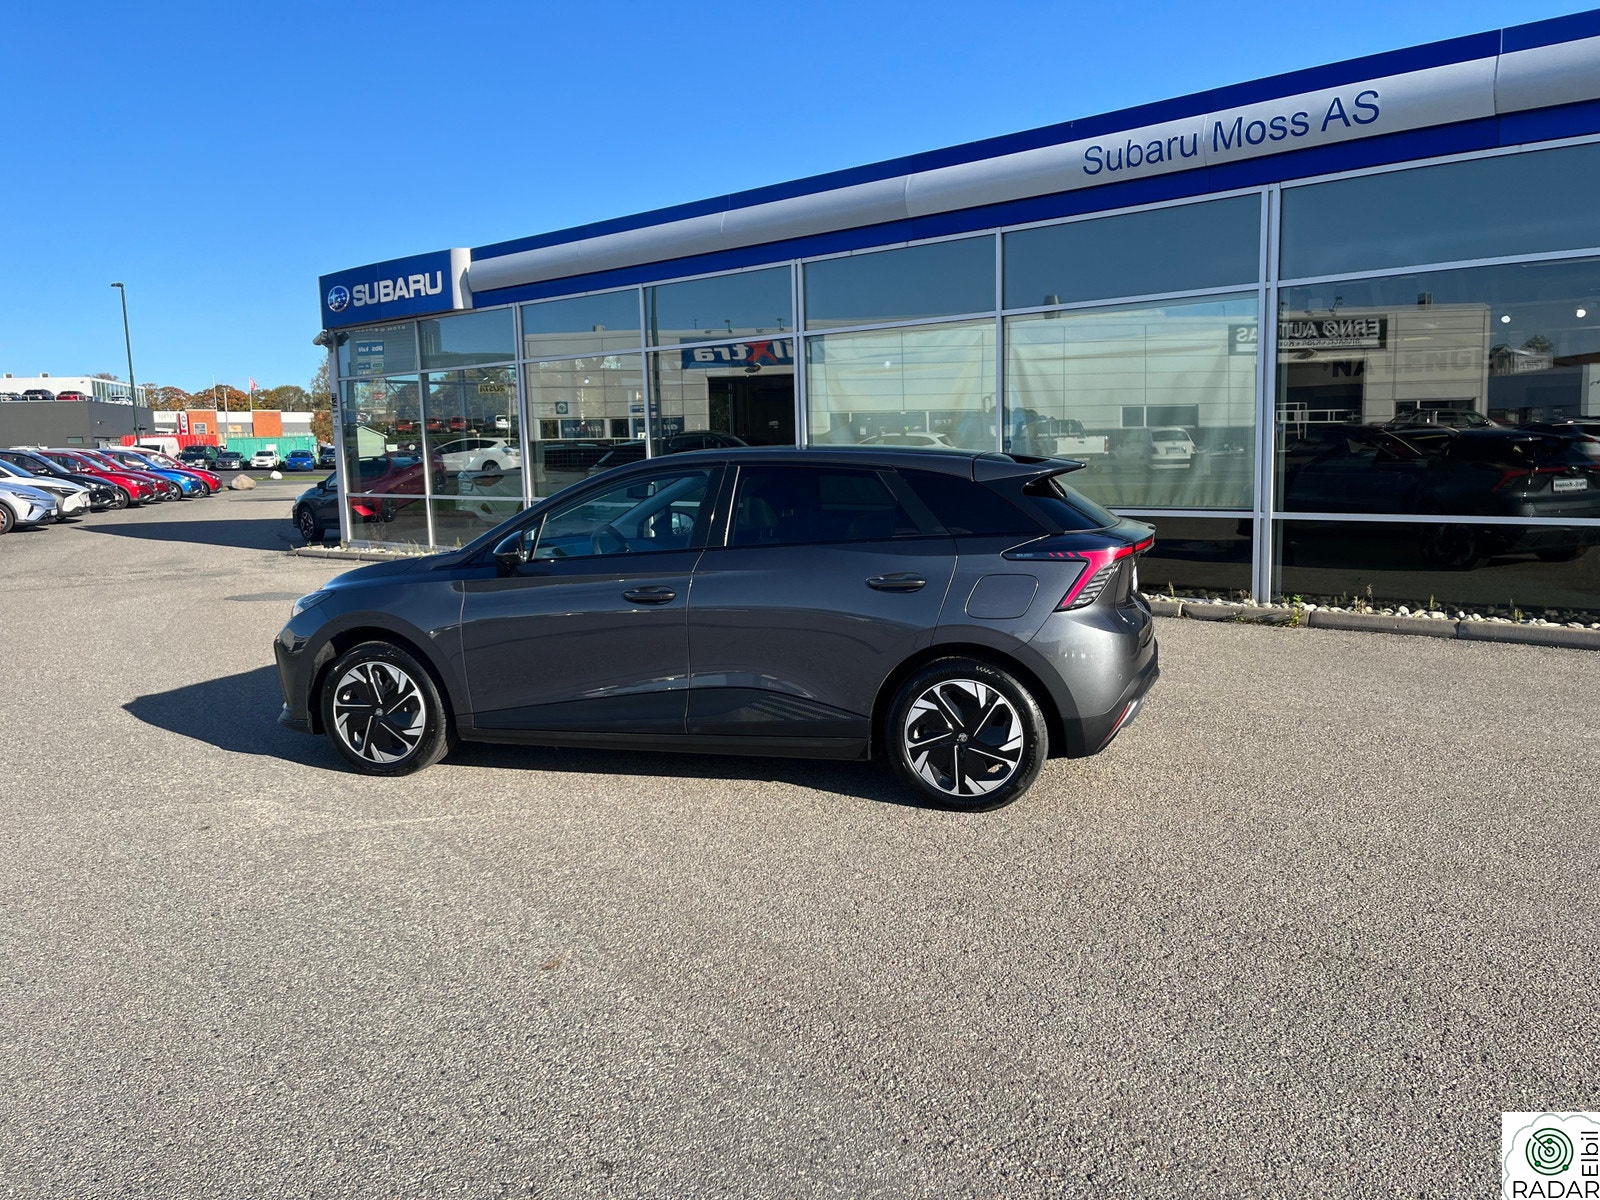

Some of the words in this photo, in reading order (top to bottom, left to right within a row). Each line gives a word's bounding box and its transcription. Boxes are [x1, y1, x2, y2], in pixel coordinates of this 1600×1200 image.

[1083, 132, 1198, 175] Subaru
[1213, 110, 1310, 152] Moss
[1320, 89, 1381, 132] AS
[352, 270, 443, 307] SUBARU
